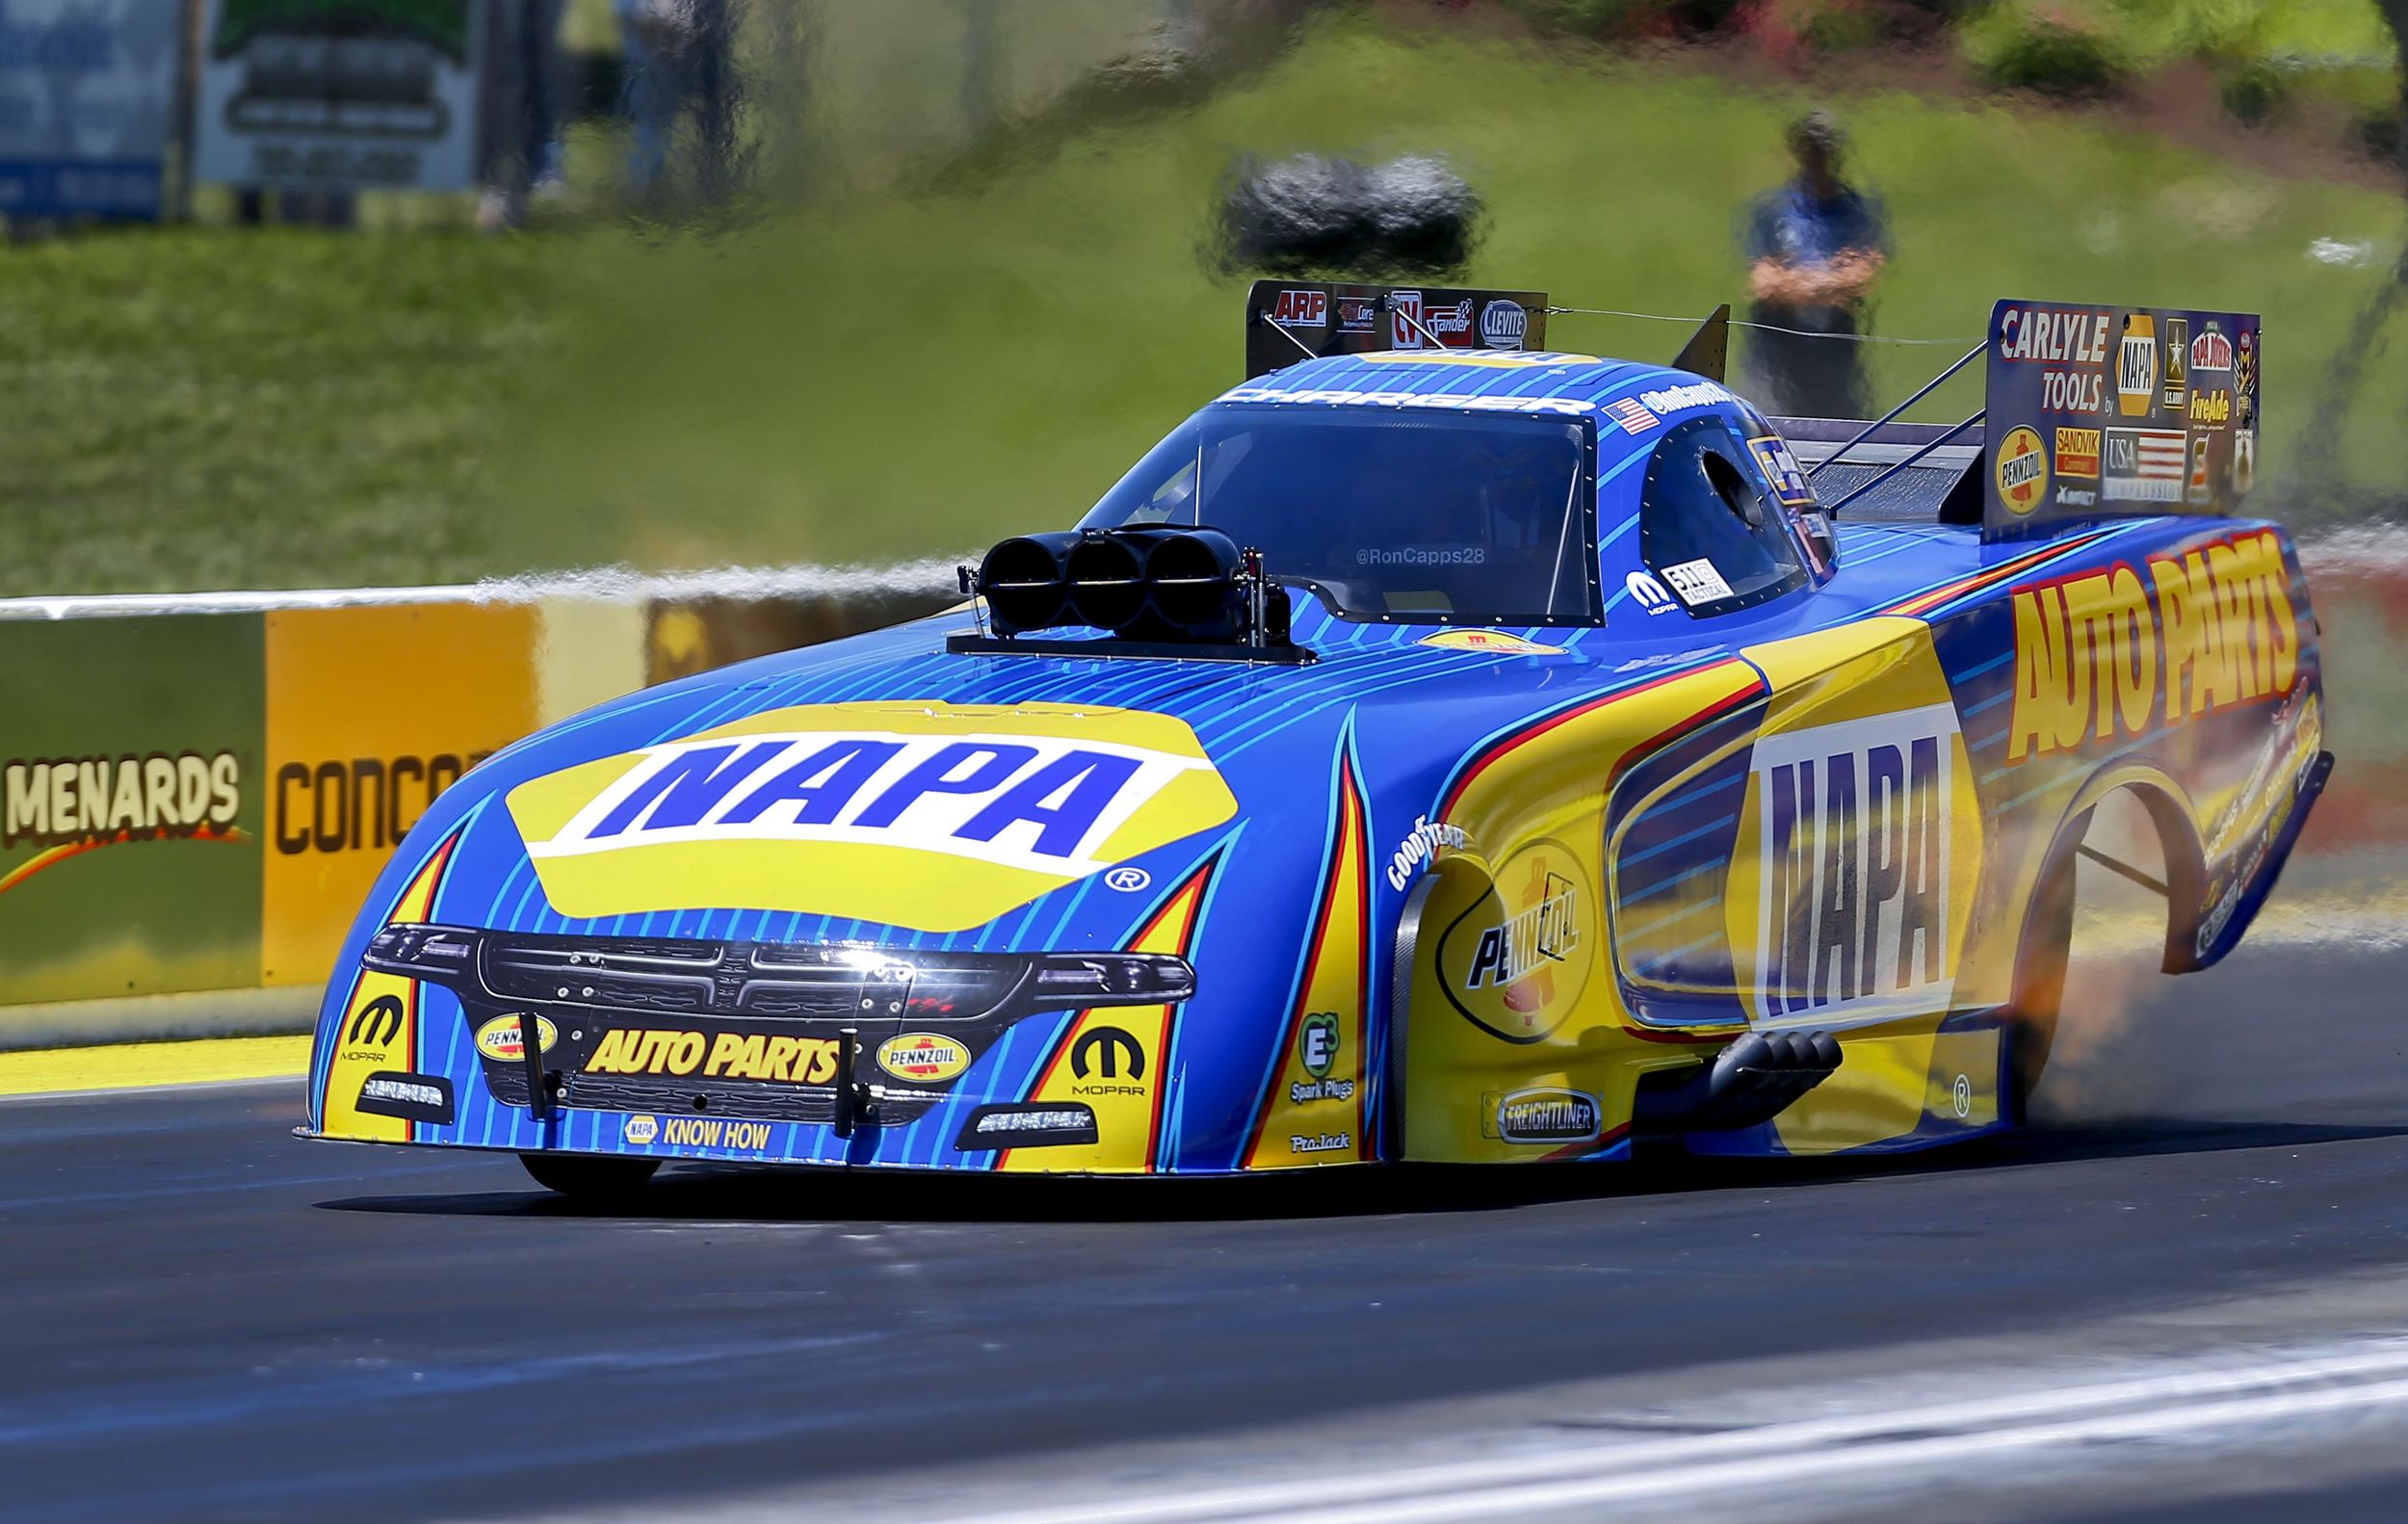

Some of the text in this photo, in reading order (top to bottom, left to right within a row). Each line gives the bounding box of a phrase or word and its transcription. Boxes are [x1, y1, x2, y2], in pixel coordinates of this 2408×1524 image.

[1275, 292, 1325, 320] ARP
[1485, 303, 1522, 335] CLEVITE
[2001, 309, 2109, 362] CARLYLE
[2122, 340, 2152, 389] NAPA
[1210, 388, 1596, 415] CHARGER
[2042, 372, 2114, 417] TOOLS by
[2190, 389, 2229, 422] FireAde
[2057, 430, 2099, 454] SANDVIK
[2109, 438, 2134, 469] USA
[2002, 451, 2042, 489] PENNZOIL
[1356, 547, 1484, 565] @RonCapps28
[1685, 583, 1727, 602] TACTICAL
[2007, 530, 2298, 763] AUTO PARTS
[5, 750, 240, 837] MENARDS
[584, 739, 1143, 858] NAPA
[1387, 814, 1464, 892] GOODYEAR
[1768, 735, 1940, 1017] NAPA
[1465, 888, 1579, 990] PENNZOIL
[339, 1051, 386, 1063] MOPAR
[585, 1030, 841, 1084] AUTO PARTS
[889, 1047, 956, 1065] PENNZOIL
[1072, 1086, 1145, 1095] MOPAR
[1292, 1079, 1353, 1103] Spark Plugs
[630, 1122, 653, 1136] NAPA
[1505, 1100, 1591, 1131] FREIGHTLINER
[663, 1118, 771, 1149] KNOW HOW
